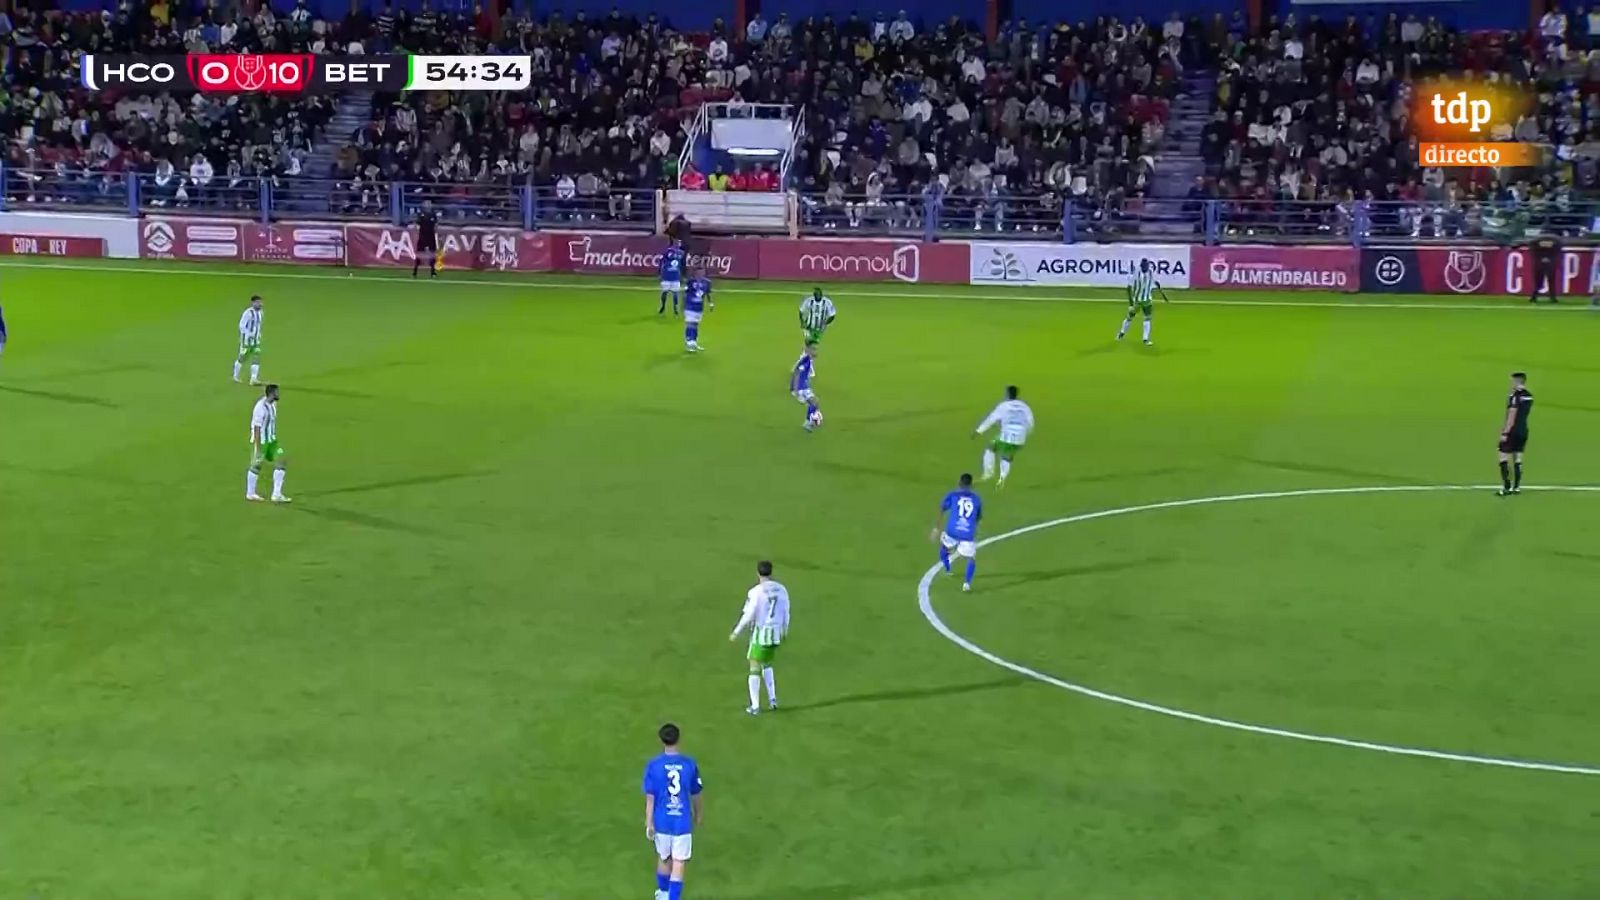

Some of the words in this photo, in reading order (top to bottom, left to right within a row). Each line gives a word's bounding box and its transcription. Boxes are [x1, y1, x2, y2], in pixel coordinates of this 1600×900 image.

[12, 237, 38, 254] COPA
[48, 239, 67, 255] REY
[1231, 269, 1347, 287] ALMENDRALEJO
[957, 498, 974, 518] 19
[768, 595, 778, 619] 7
[667, 769, 681, 795] 3
